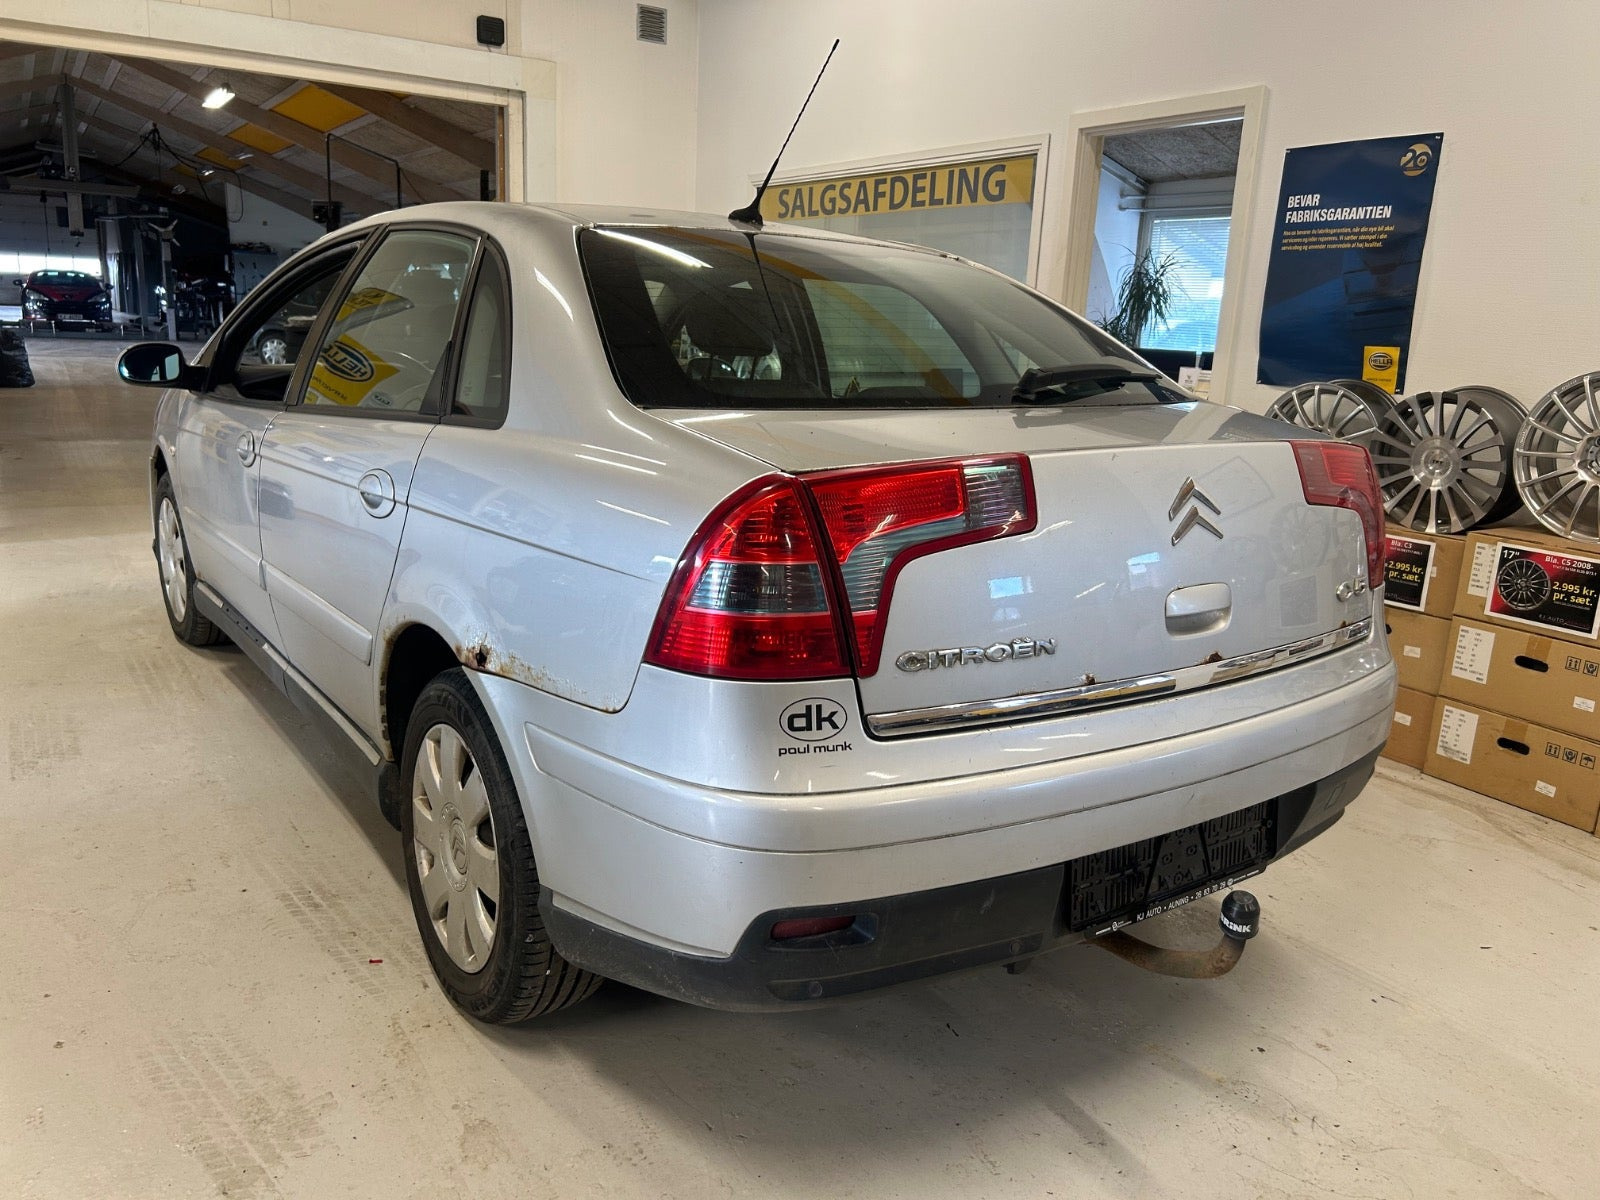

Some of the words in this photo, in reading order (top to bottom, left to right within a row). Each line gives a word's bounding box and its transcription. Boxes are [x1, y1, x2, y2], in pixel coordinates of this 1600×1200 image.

[777, 164, 1007, 219] SALGSAFDELING
[1287, 194, 1320, 208] BEVAR
[1285, 205, 1392, 223] FABRIKSGARANTIEN
[1371, 358, 1393, 366] HELLA
[1503, 549, 1520, 559] 17"
[1388, 560, 1411, 572] 2.995
[1412, 565, 1424, 575] kr.
[1545, 556, 1559, 565] Bla.
[1572, 560, 1594, 570] 2008-
[1389, 571, 1400, 579] pr.
[1402, 573, 1421, 583] sæt.
[1552, 581, 1580, 594] 2.995
[1582, 586, 1598, 598] kr.
[1552, 592, 1567, 601] pr.
[1570, 595, 1593, 606] sæt.
[896, 636, 1056, 672] CITROËN
[787, 704, 840, 732] dk
[813, 741, 852, 753] munk
[1136, 912, 1145, 921] KJ
[1146, 906, 1162, 918] AUTO
